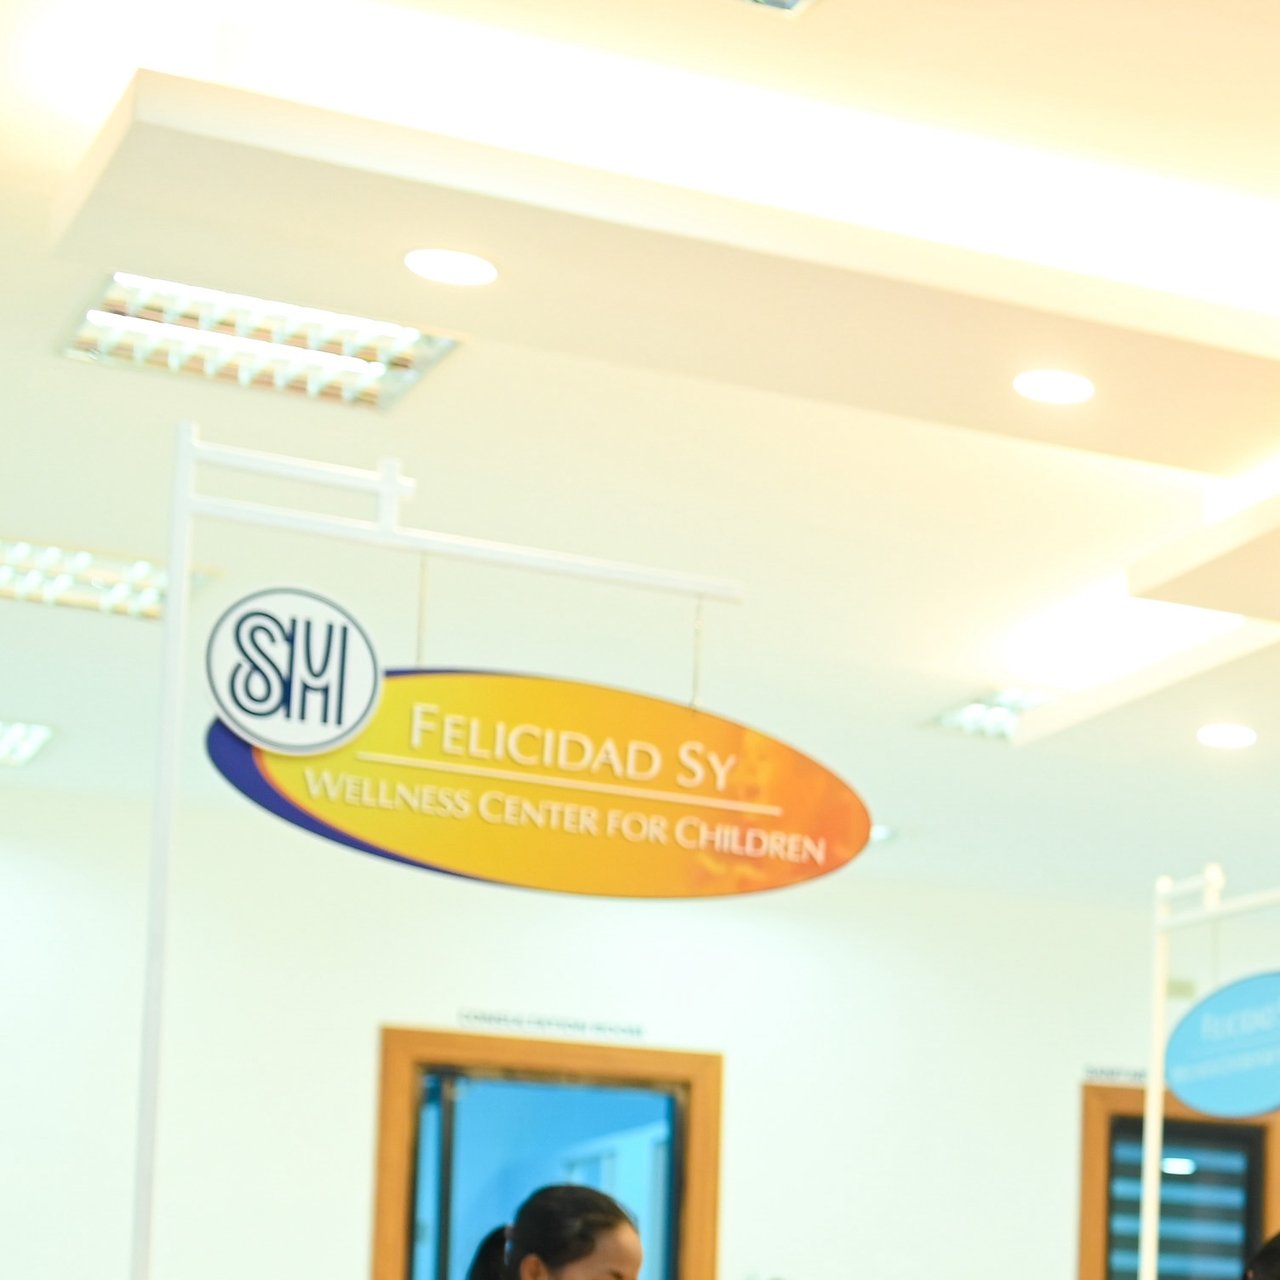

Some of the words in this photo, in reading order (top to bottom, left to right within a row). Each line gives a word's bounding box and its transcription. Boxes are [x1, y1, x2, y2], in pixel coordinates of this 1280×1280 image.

[231, 612, 347, 727] SM
[304, 767, 472, 820] WELLNESS
[478, 790, 599, 837] CENTER
[607, 808, 669, 845] FOR
[675, 815, 827, 867] CHILDREN
